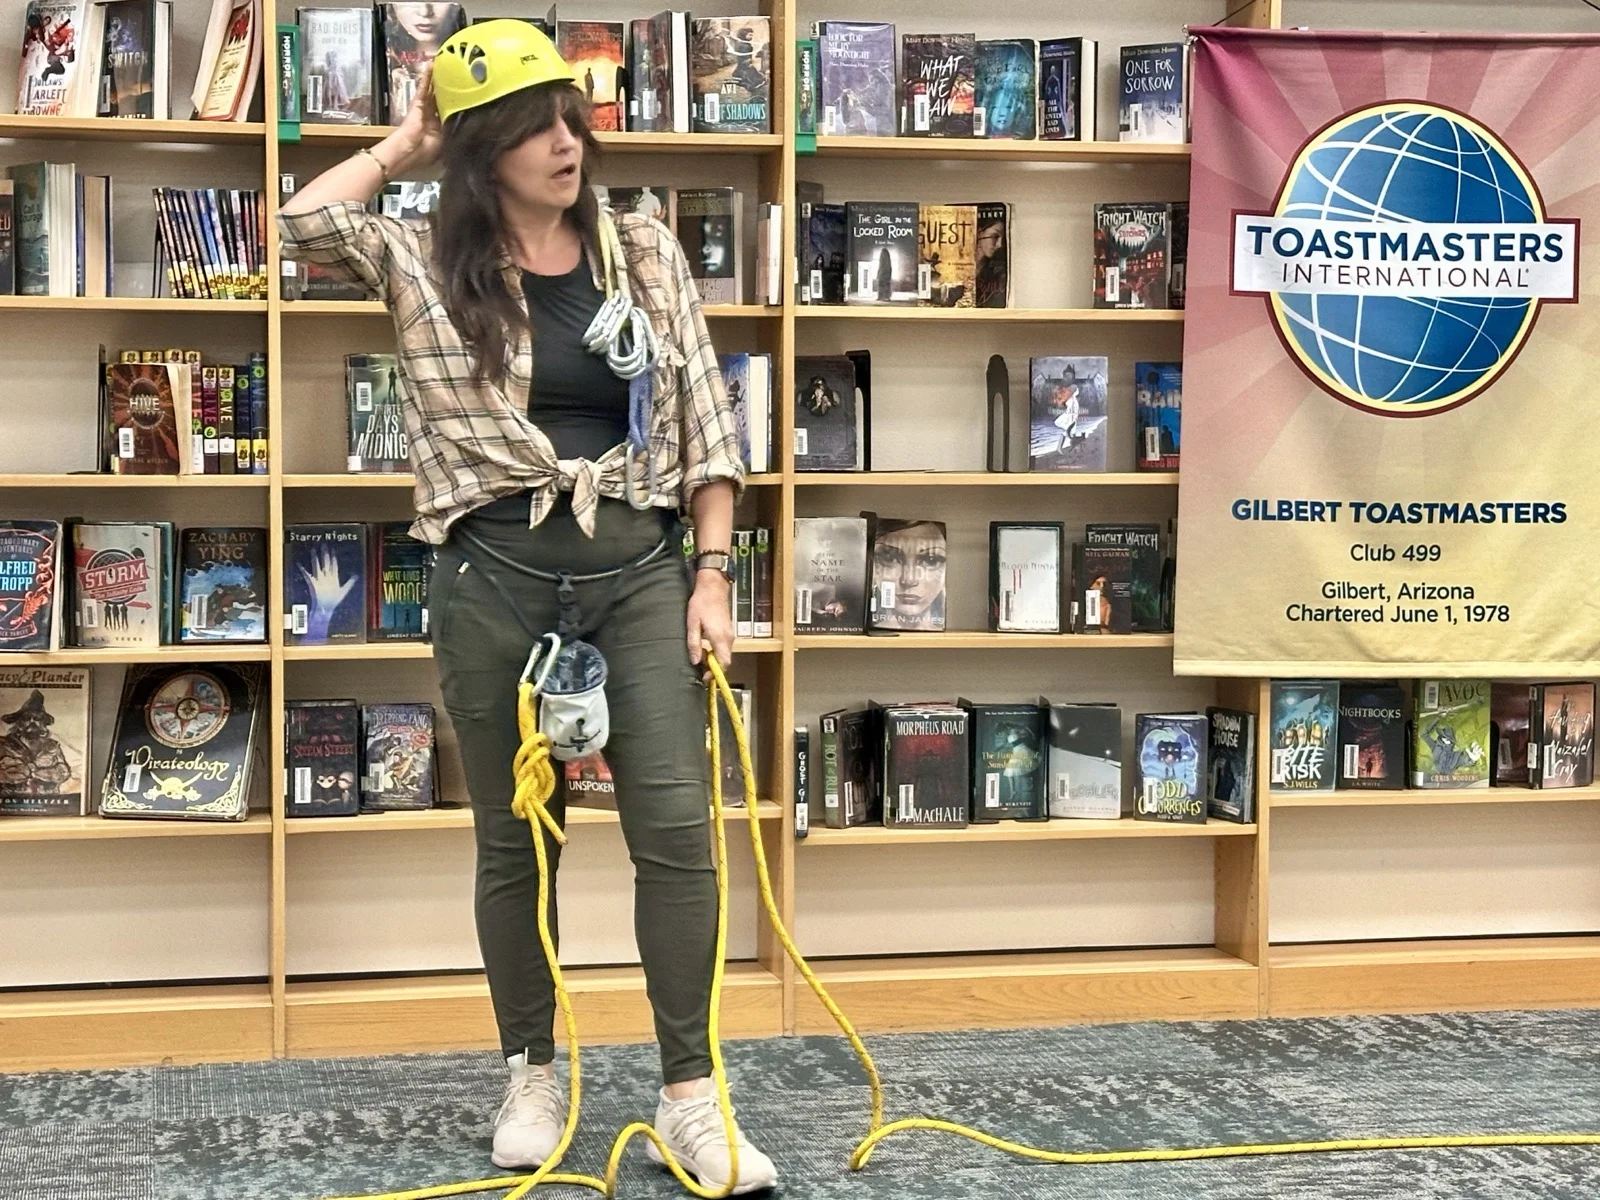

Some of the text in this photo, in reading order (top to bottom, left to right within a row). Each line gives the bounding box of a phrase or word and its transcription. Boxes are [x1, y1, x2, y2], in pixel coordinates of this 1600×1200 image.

[311, 23, 358, 34] BAD GIRLS
[828, 33, 864, 42] LOOK FOR
[107, 51, 148, 68] SWITCH
[283, 35, 291, 74] HORROR
[828, 50, 870, 60] MOONLIGHT
[802, 50, 810, 91] HORROR
[920, 55, 965, 79] WHAT
[1125, 58, 1175, 77] ONE FOR
[721, 83, 737, 94] AVI
[926, 78, 950, 98] WE
[1125, 75, 1175, 94] SORROW
[726, 103, 766, 120] SHADOWS
[928, 95, 957, 118] AW
[858, 213, 871, 224] THE
[874, 214, 894, 224] GIRL
[1096, 209, 1166, 237] FRIGHT WATCH
[853, 224, 913, 239] LOCKED ROOM
[1247, 225, 1563, 263] TOASTMASTERS
[1281, 263, 1530, 288] INTERNATIONAL
[129, 396, 160, 412] HIVE
[225, 391, 230, 399] 5
[206, 428, 213, 437] 6
[367, 414, 399, 433] DAYS
[1232, 499, 1567, 524] GILBERT TOASTMASTERS
[189, 532, 256, 542] ZACHARY
[290, 531, 358, 542] Starry Nights
[1125, 531, 1159, 551] WATCH
[198, 546, 244, 559] YING
[1350, 543, 1441, 562] Club 499
[84, 562, 146, 589] STORM
[1321, 581, 1475, 603] Gilbert, Arizona
[872, 613, 945, 625] BRIAN JAMES
[1286, 603, 1510, 625] Chartered June 1, 1978
[1339, 706, 1401, 719] NIGHTBOOKS
[896, 720, 964, 736] MORPHEUS ROAD
[1213, 713, 1241, 733] SHADOW
[1214, 730, 1239, 748] HOUSE
[125, 745, 229, 782] Pirateology
[825, 744, 837, 767] ROT
[798, 751, 806, 785] GHOST
[1284, 764, 1322, 780] RISK
[1554, 759, 1578, 783] Cray
[568, 780, 615, 793] UNSPOKEN
[912, 806, 965, 823] MACHALE
